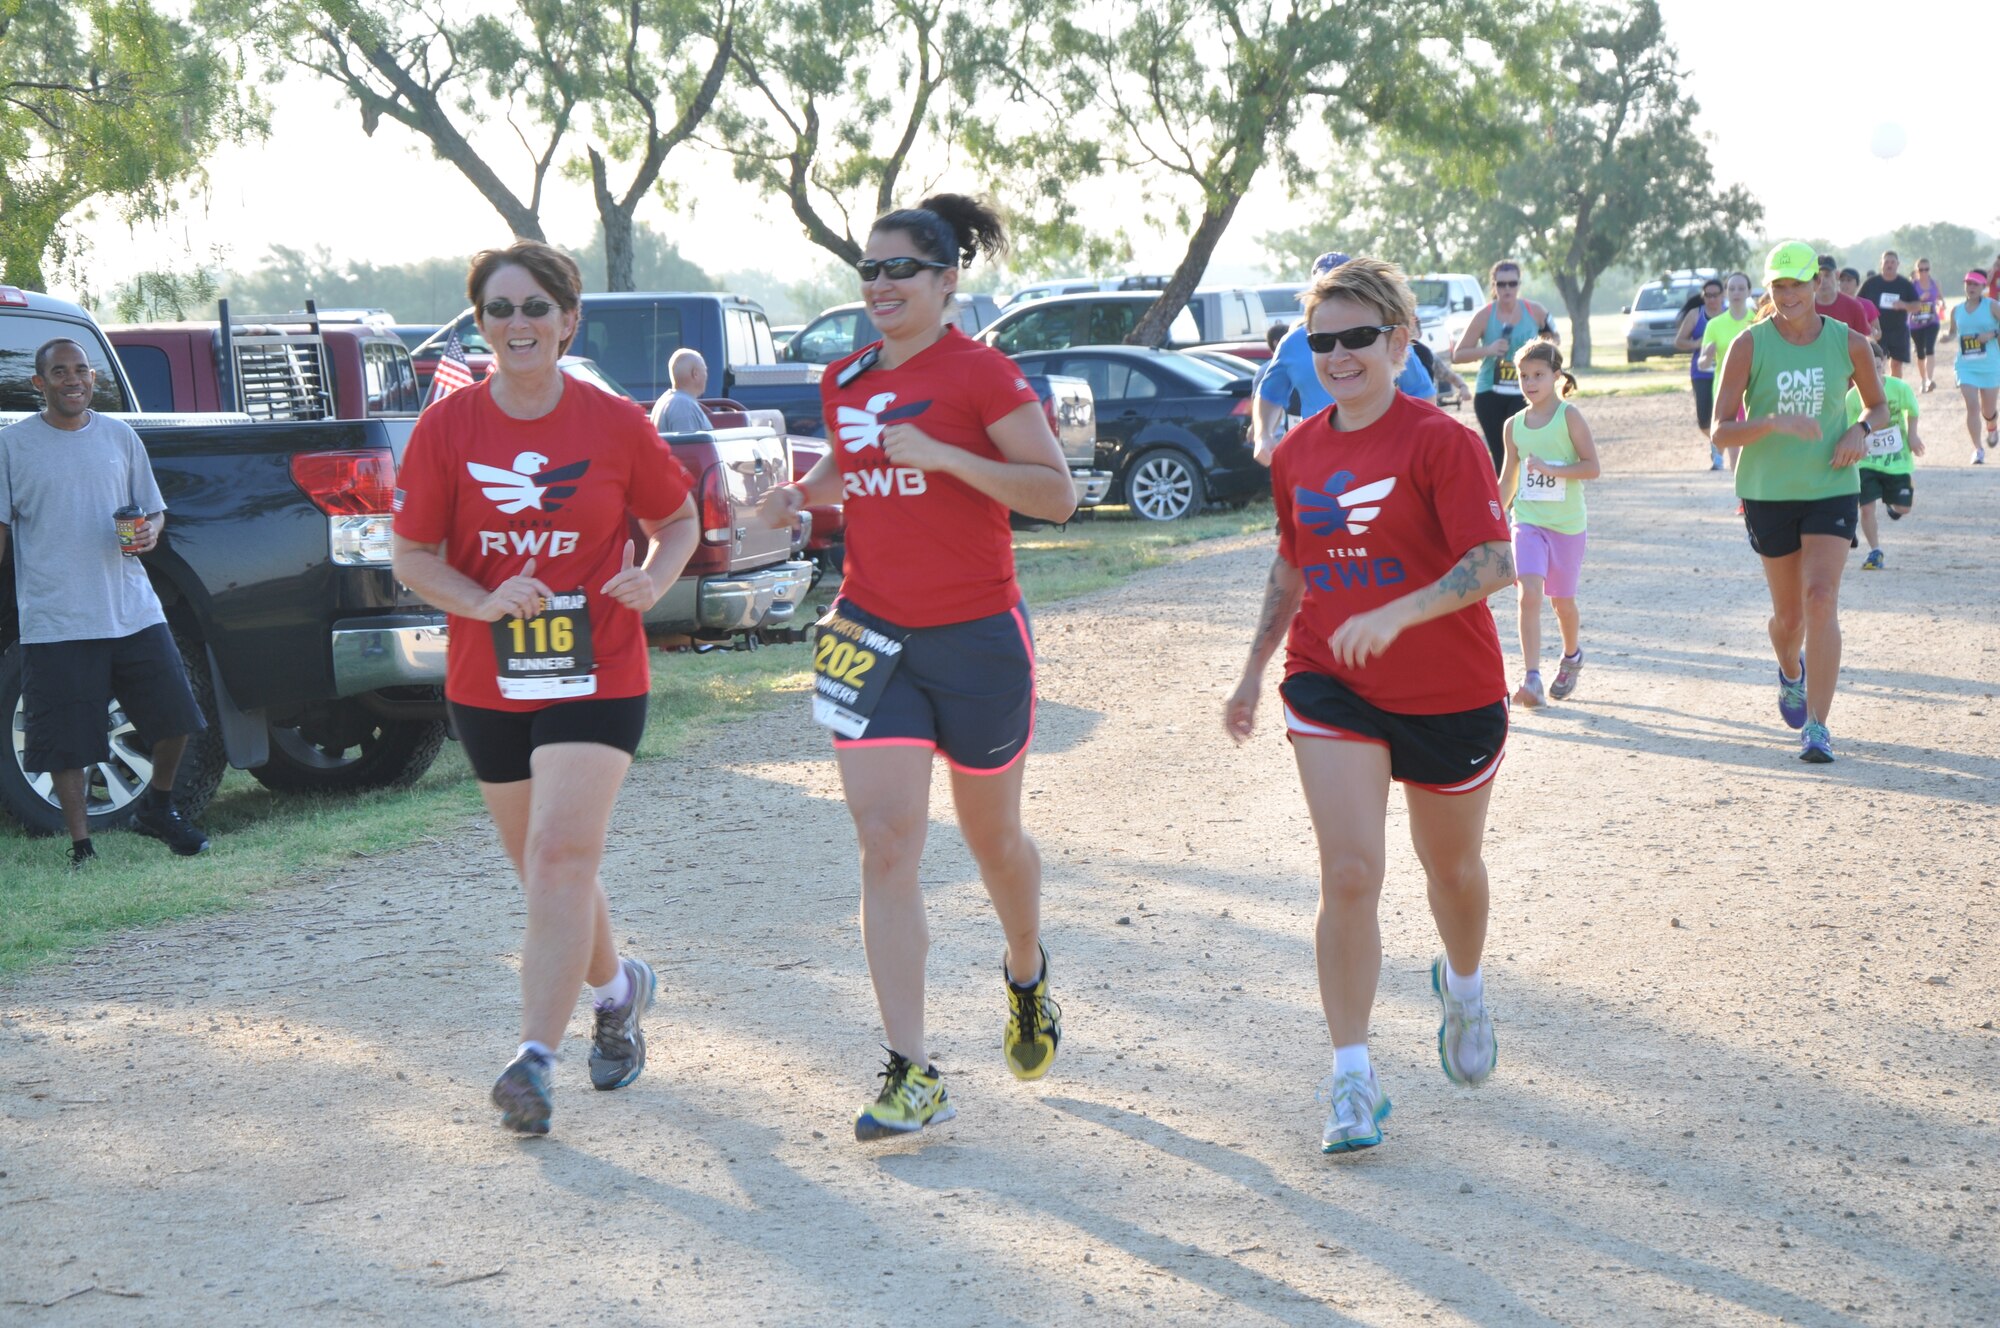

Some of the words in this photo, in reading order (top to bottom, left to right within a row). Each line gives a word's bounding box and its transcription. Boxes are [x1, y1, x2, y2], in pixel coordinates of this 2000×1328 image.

[1777, 367, 1824, 390] ONE
[1780, 387, 1825, 402] MORE
[1873, 435, 1895, 447] 519
[843, 467, 927, 500] RWB
[1527, 474, 1556, 488] 548
[479, 530, 580, 558] RWB
[1327, 548, 1367, 558] TEAM
[1303, 557, 1407, 593] RWB
[553, 595, 587, 610] WRAP
[507, 616, 574, 653] 116
[822, 613, 865, 641] PORTS
[508, 656, 575, 670] RUNNERS
[815, 633, 876, 688] 202
